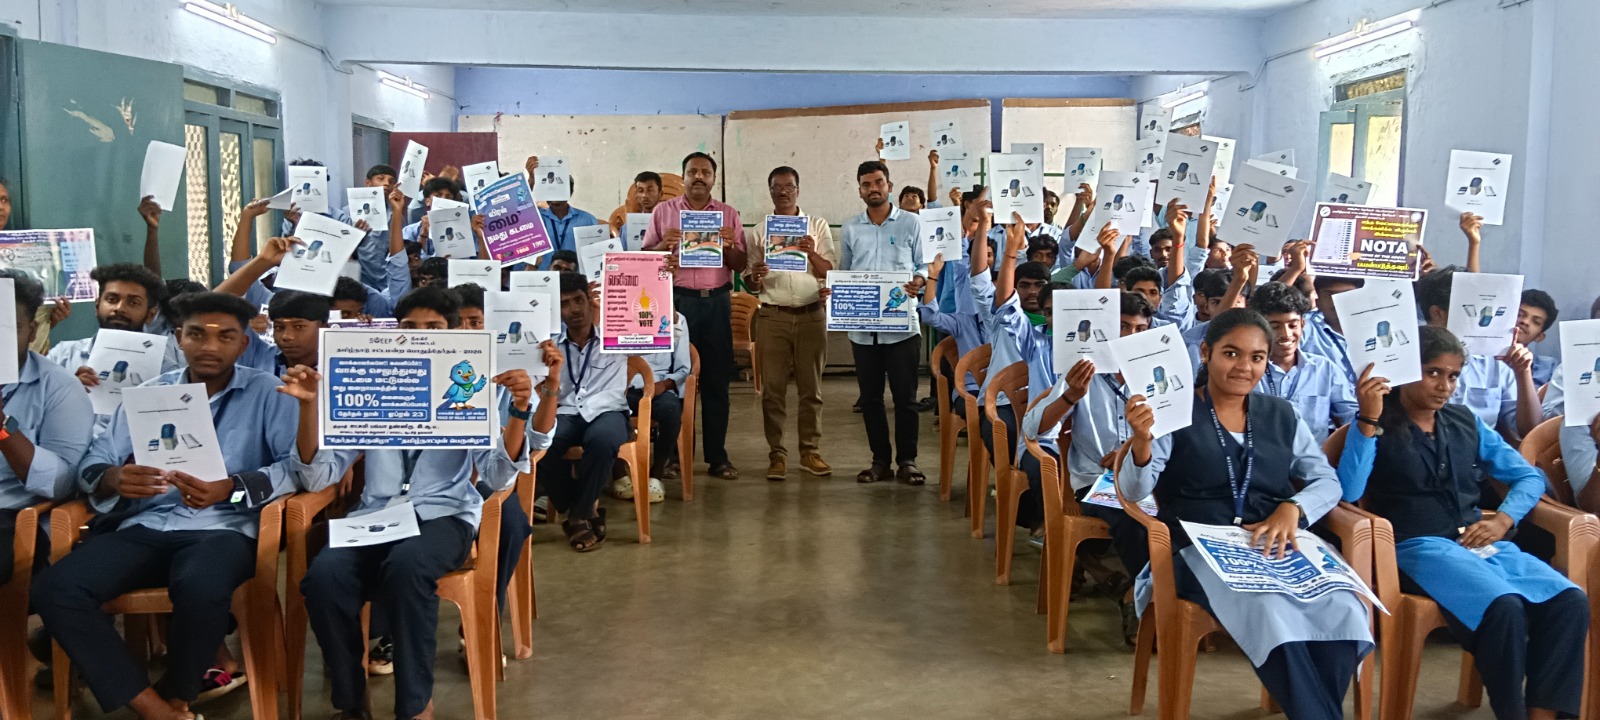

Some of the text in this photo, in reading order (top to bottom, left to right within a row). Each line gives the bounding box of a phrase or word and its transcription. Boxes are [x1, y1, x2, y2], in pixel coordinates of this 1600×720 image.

[488, 206, 508, 218] விரல்
[487, 231, 508, 244] நமது
[509, 222, 534, 236] கடமை
[1360, 239, 1408, 254] NOTA
[608, 272, 638, 286] வலிமை
[335, 366, 427, 377] வாக்கு செலுத்துவது
[375, 376, 420, 385] மட்டுமல்ல
[335, 394, 379, 407] 100%
[1220, 556, 1264, 569] 100%
